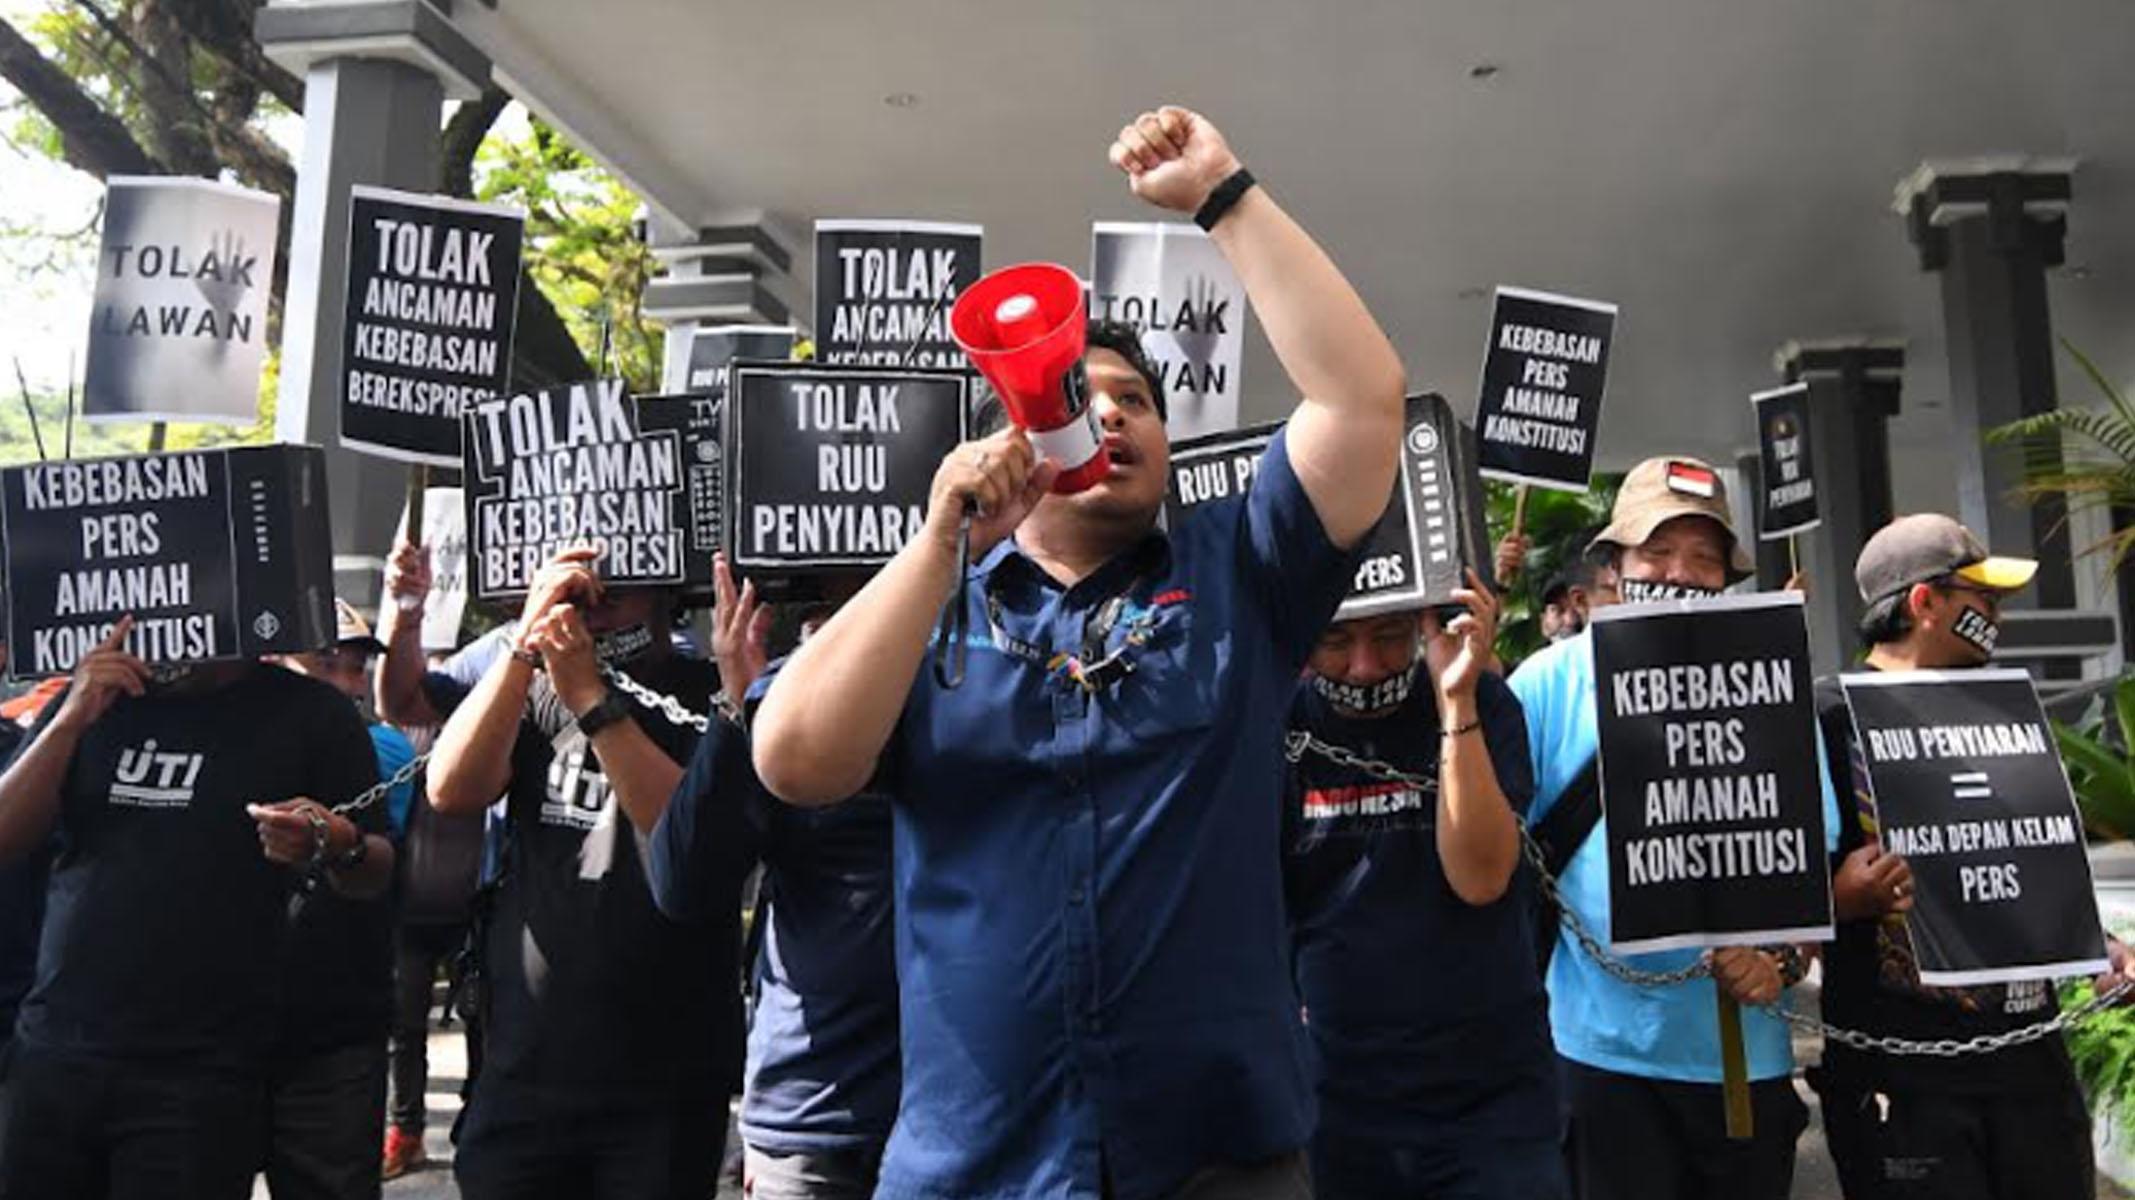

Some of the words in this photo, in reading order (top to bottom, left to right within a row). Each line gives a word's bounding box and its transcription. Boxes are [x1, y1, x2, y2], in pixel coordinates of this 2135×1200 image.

[109, 244, 258, 287] TOLAK
[375, 219, 495, 286] TOLAK
[839, 248, 956, 299] TOLAK
[102, 305, 253, 343] LAWAN
[364, 278, 497, 330] ANCAMAN
[355, 323, 497, 376] KEBEBASAN
[1500, 323, 1601, 364] KEBEBASAN
[348, 370, 496, 419] BEREKSPRE
[1523, 358, 1569, 389] PERS
[478, 379, 633, 466] TOLAK
[791, 383, 900, 433] TOLAK
[1502, 386, 1580, 421] AMANAH
[1484, 414, 1588, 455] KONSTITUSI
[24, 455, 208, 511] KEBEBASAN
[510, 438, 675, 499] ANCAMAN
[818, 445, 886, 492] RUU
[1177, 461, 1228, 505] RUU
[82, 511, 160, 559] PERS
[483, 490, 664, 549] KEBEBASAN
[753, 504, 926, 553] PENYIARA
[486, 534, 677, 589] BERPRESI
[56, 563, 190, 616] AMANAH
[1612, 659, 1794, 717] KEBEBASAN
[1666, 719, 1746, 768] PERS
[1868, 728, 1915, 762] RUU
[1923, 722, 2047, 760] PENYIARAN
[1645, 773, 1779, 827] AMANAH
[1626, 828, 1807, 887] KONSTITUSI
[1888, 825, 1943, 857] MASA
[1948, 820, 2010, 854] DEPAN
[2013, 815, 2077, 849] KELAM
[1960, 865, 2021, 903] PERS
